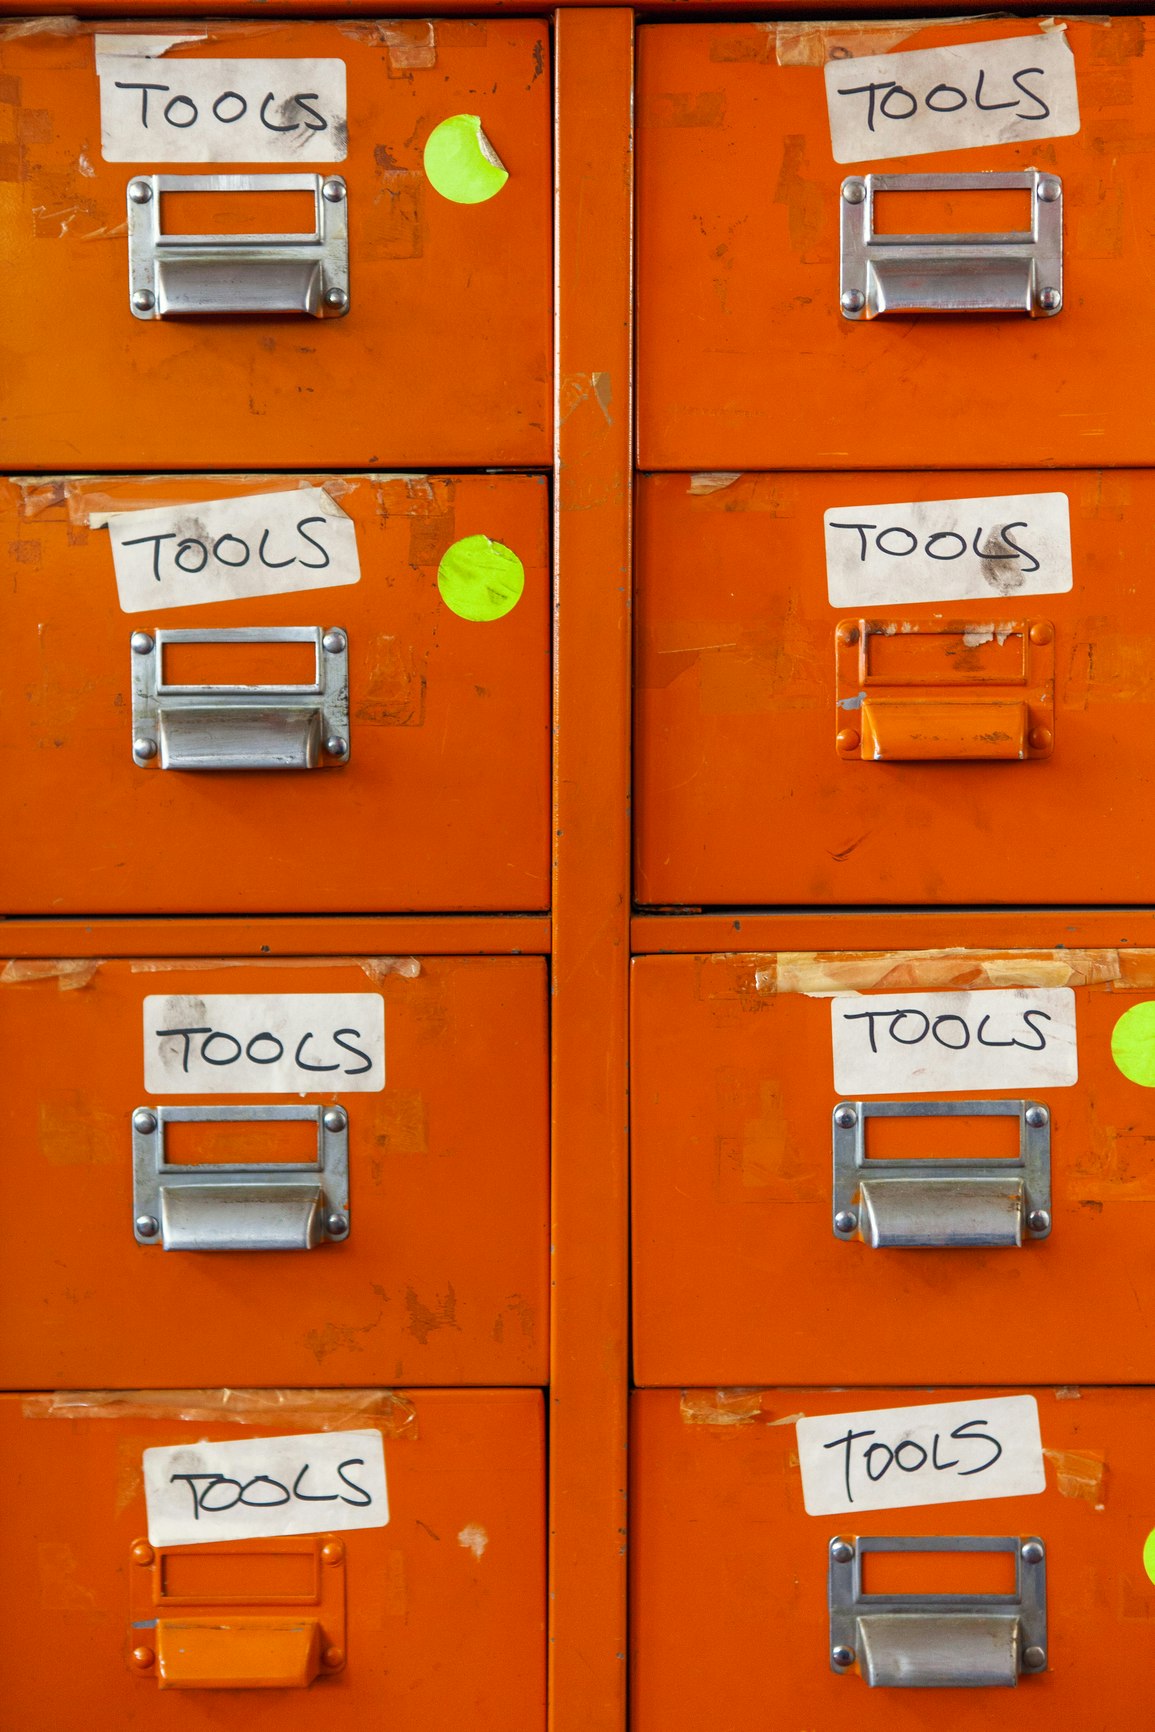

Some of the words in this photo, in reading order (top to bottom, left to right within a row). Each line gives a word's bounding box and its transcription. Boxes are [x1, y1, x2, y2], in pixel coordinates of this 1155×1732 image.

[115, 82, 328, 131] TOOLS
[838, 68, 1050, 132] TOOLS
[121, 516, 330, 581] TOOLS
[829, 522, 1040, 572] TOOLS
[156, 1028, 373, 1075] TOOLS
[843, 1009, 1051, 1053] TOOLS
[170, 1458, 372, 1520] TOOLS
[823, 1420, 1002, 1503] TOOLS
